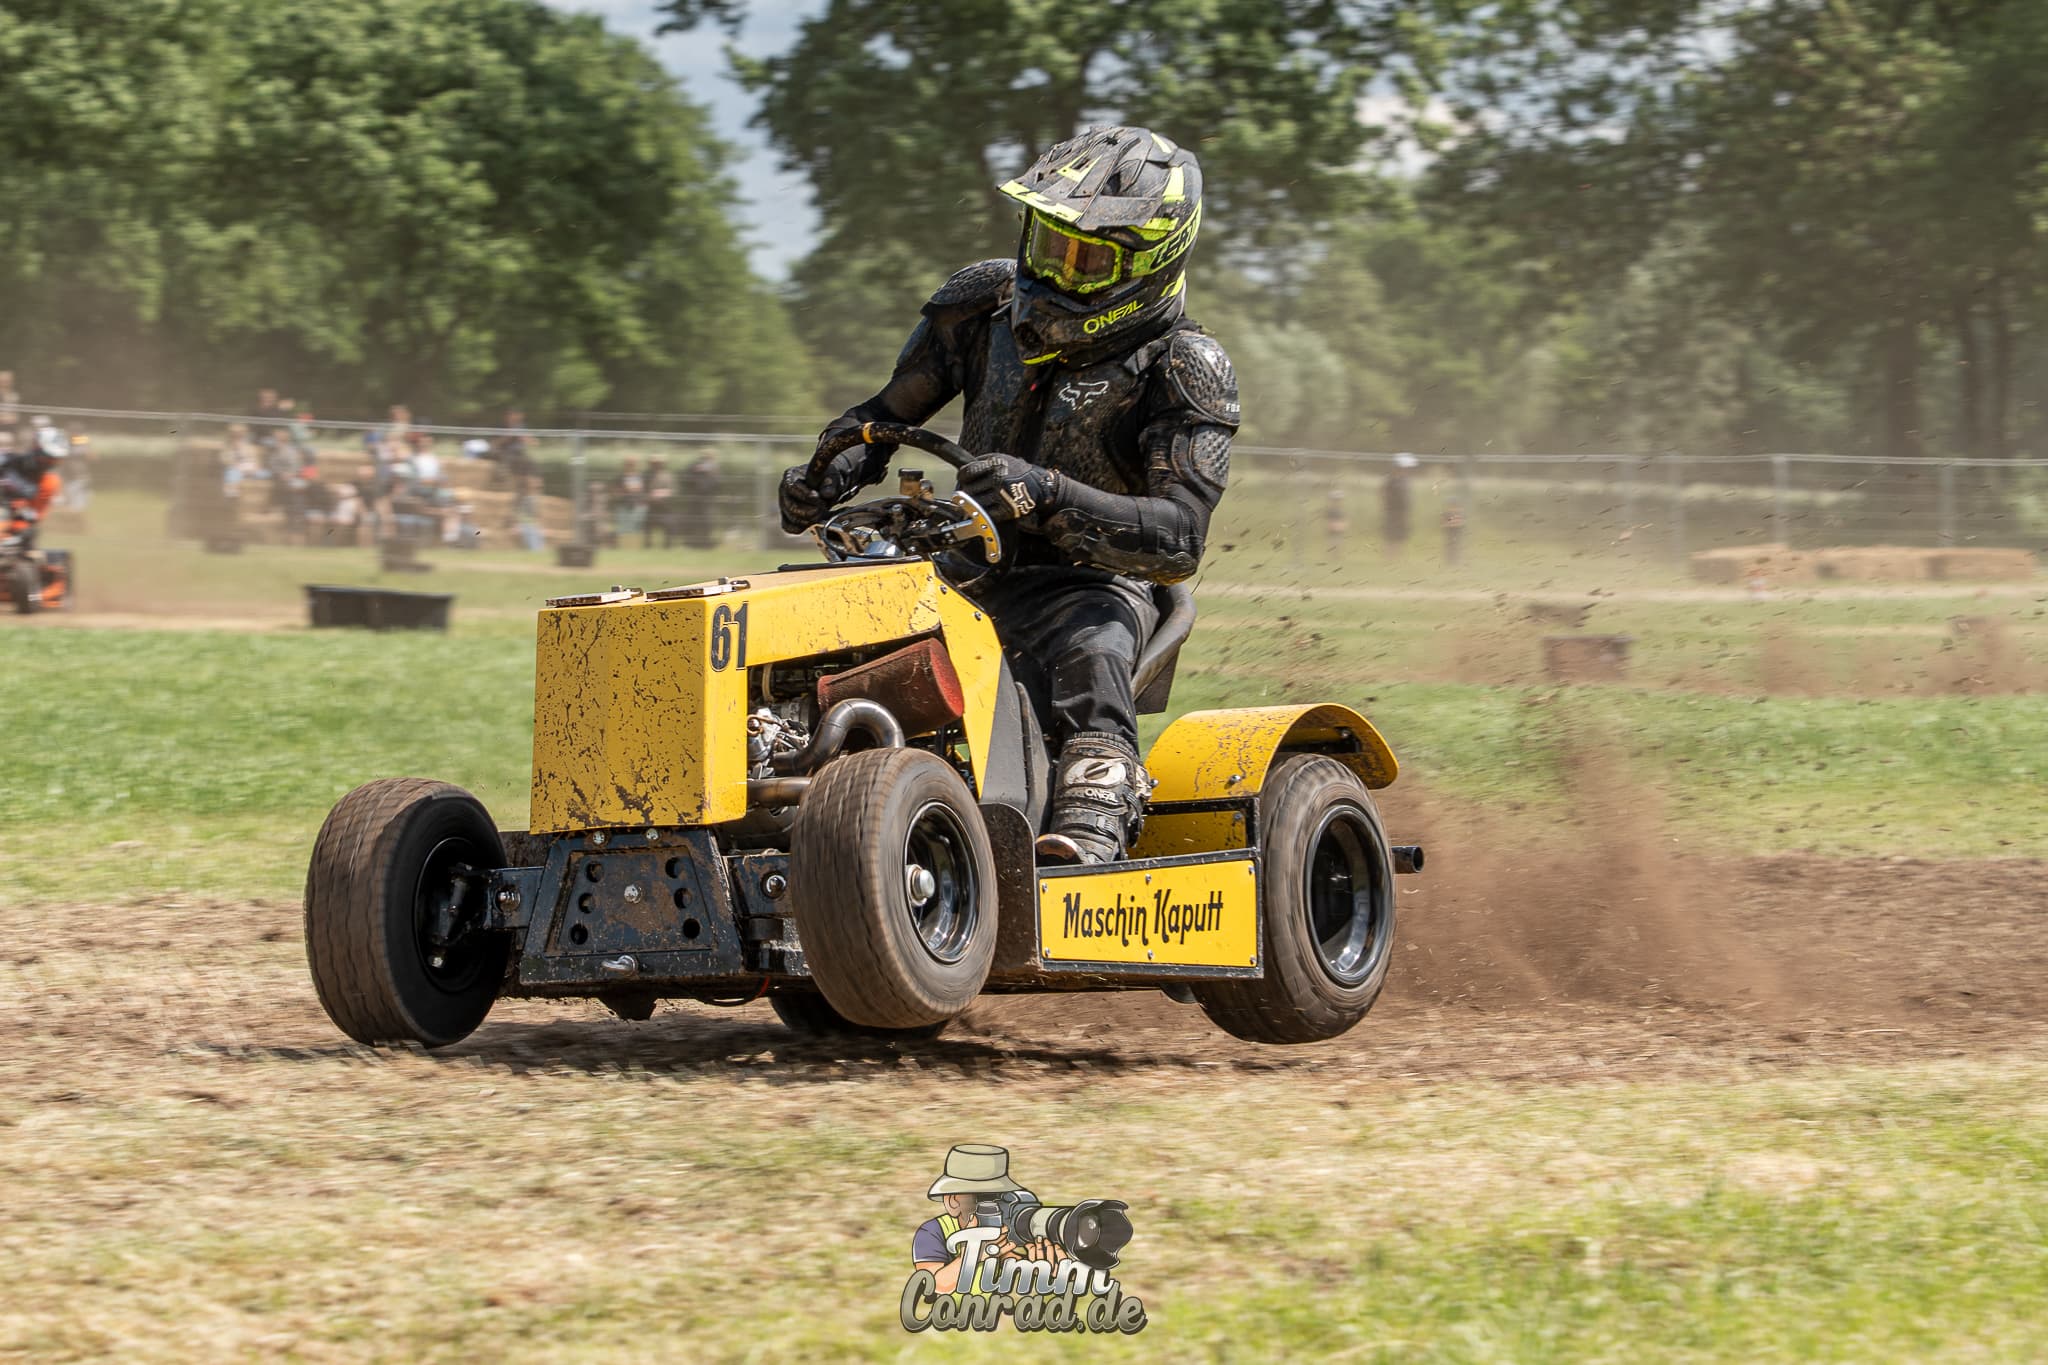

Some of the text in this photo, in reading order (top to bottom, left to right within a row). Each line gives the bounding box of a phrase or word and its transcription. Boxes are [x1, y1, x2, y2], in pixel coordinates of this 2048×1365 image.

[710, 601, 749, 672] 61
[1063, 888, 1224, 947] Maschin Kaputt
